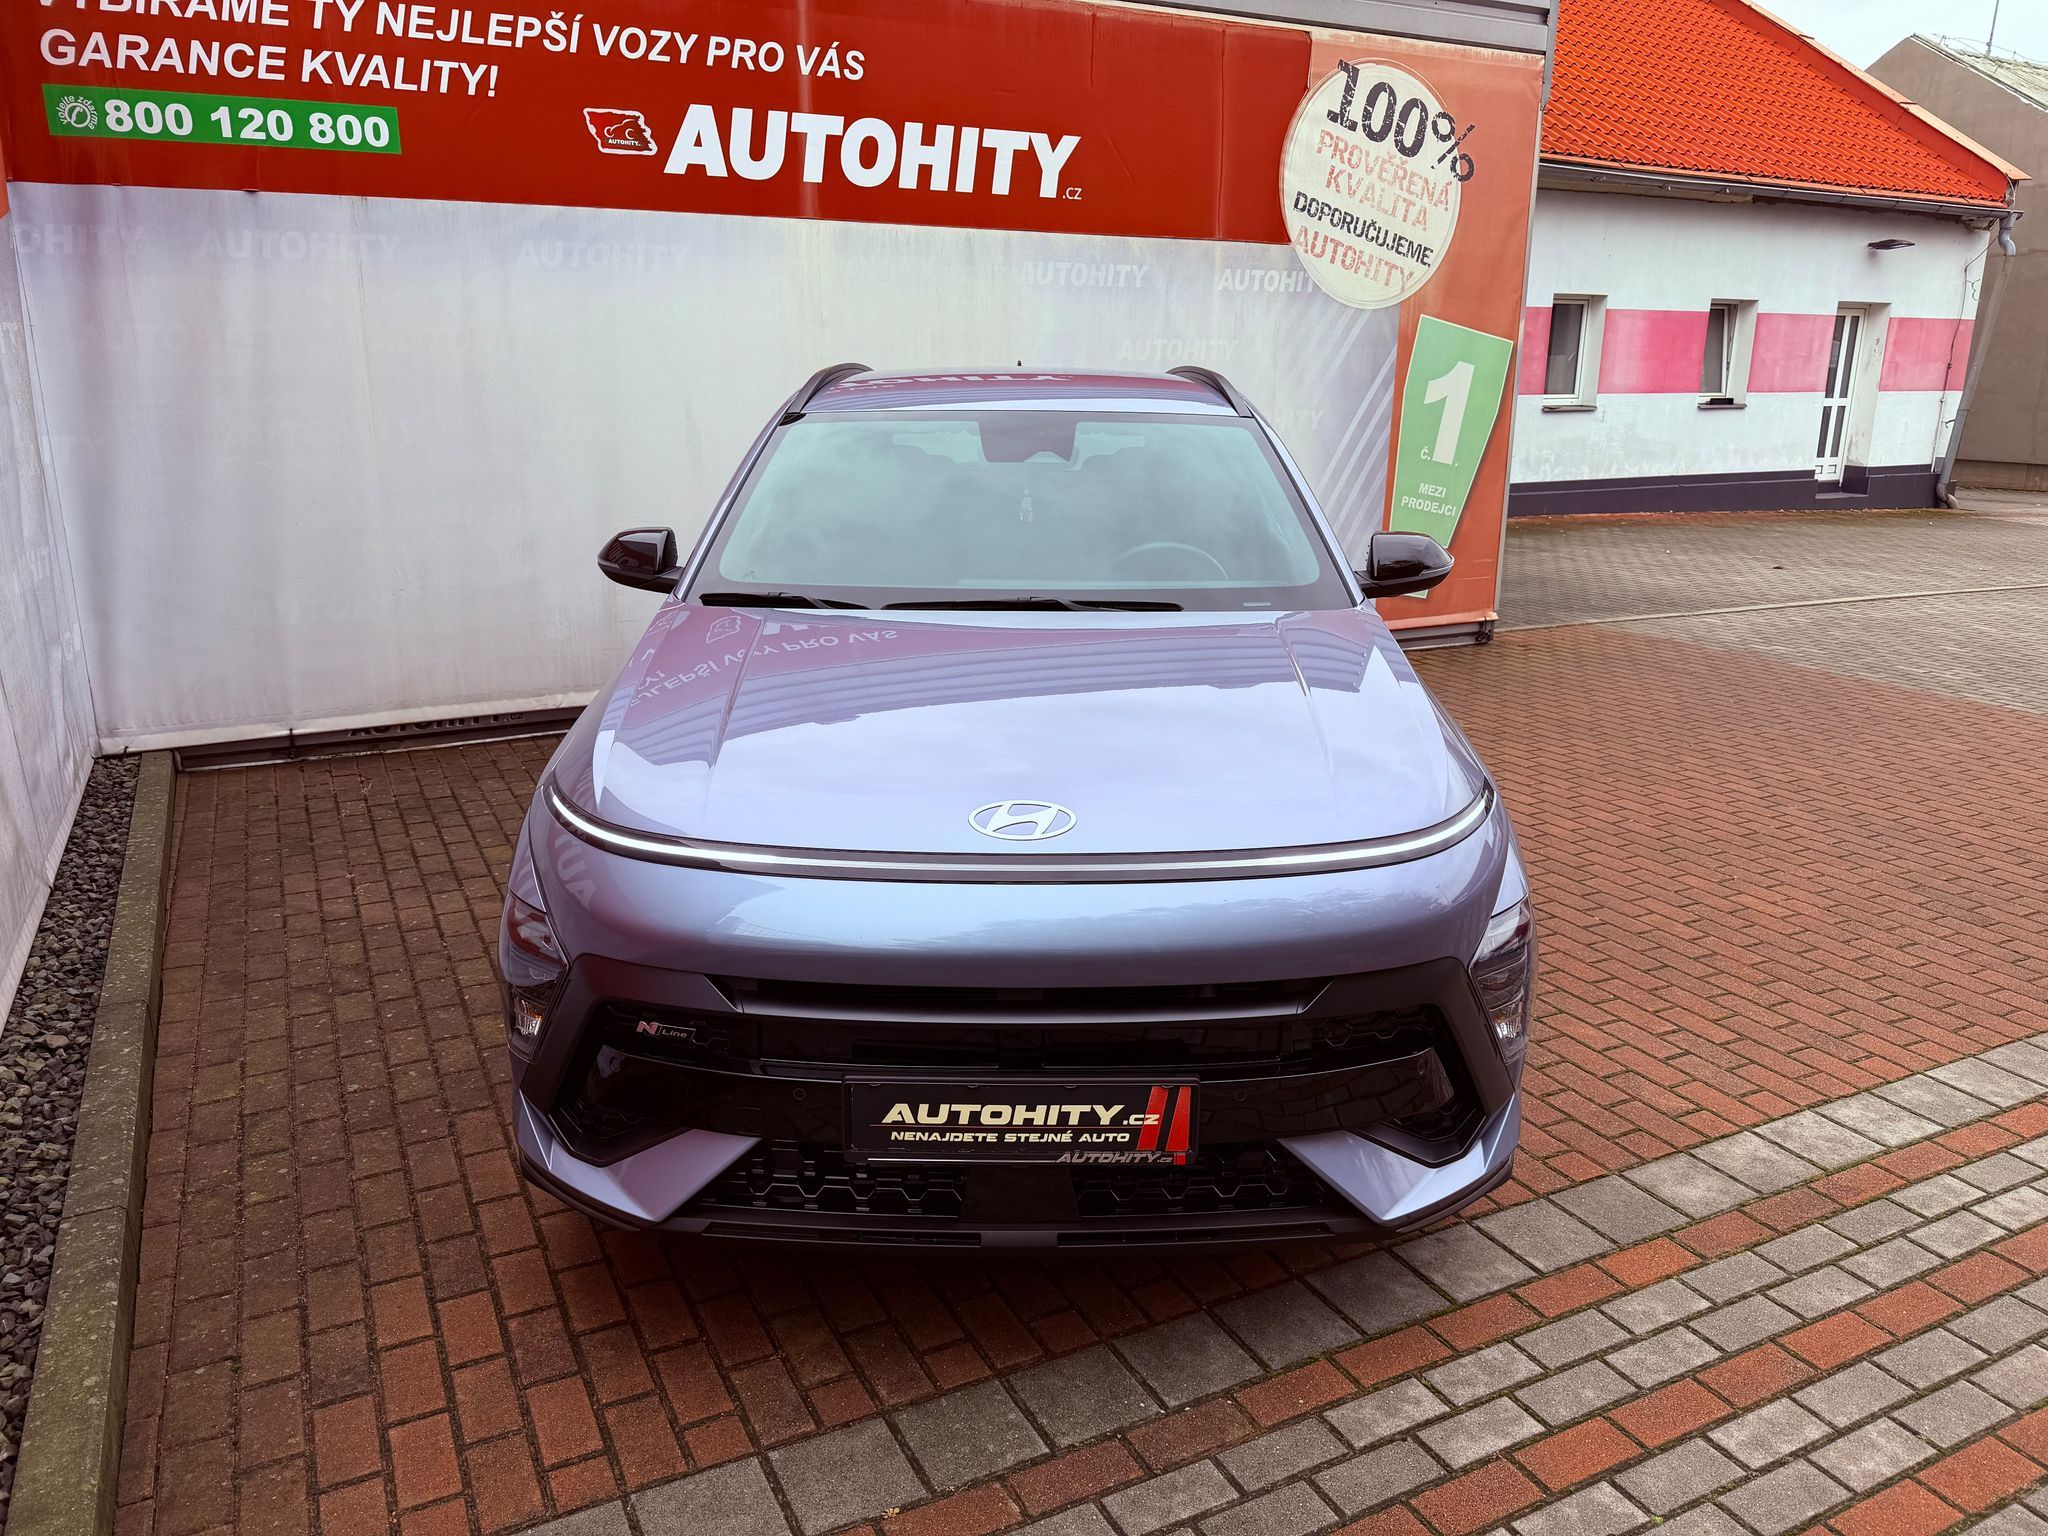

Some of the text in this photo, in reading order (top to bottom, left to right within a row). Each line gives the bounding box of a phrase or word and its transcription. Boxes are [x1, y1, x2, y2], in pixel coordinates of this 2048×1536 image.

[310, 0, 366, 32] TY
[376, 1, 583, 53] NEJLEPŠÍ
[592, 23, 699, 64] VOZY
[706, 35, 785, 73] PRO
[796, 41, 866, 81] VÁS
[40, 28, 499, 98] GARANCE KVALITY!
[77, 96, 98, 130] zdarma
[104, 98, 390, 148] 800 120 800
[1326, 58, 1476, 183] 100%
[1315, 128, 1453, 213] PROVĚŘENÁ
[1325, 164, 1430, 232] KVALITA
[1293, 190, 1434, 268] DOPORUČUJEME
[201, 229, 403, 265] AUTOHITY
[514, 238, 694, 272] AUTOHITY
[1293, 225, 1417, 293] AUTOHITY
[1020, 260, 1149, 289] AUTOHITY
[1217, 268, 1315, 293] AUTOHIT
[1116, 337, 1239, 362] AUTOHITY
[1400, 496, 1457, 517] PRODEJCI
[1419, 482, 1447, 499] MEZI
[636, 1020, 688, 1038] N Line
[890, 1130, 1131, 1143] NENAJDETE STEJNÉ AUTO
